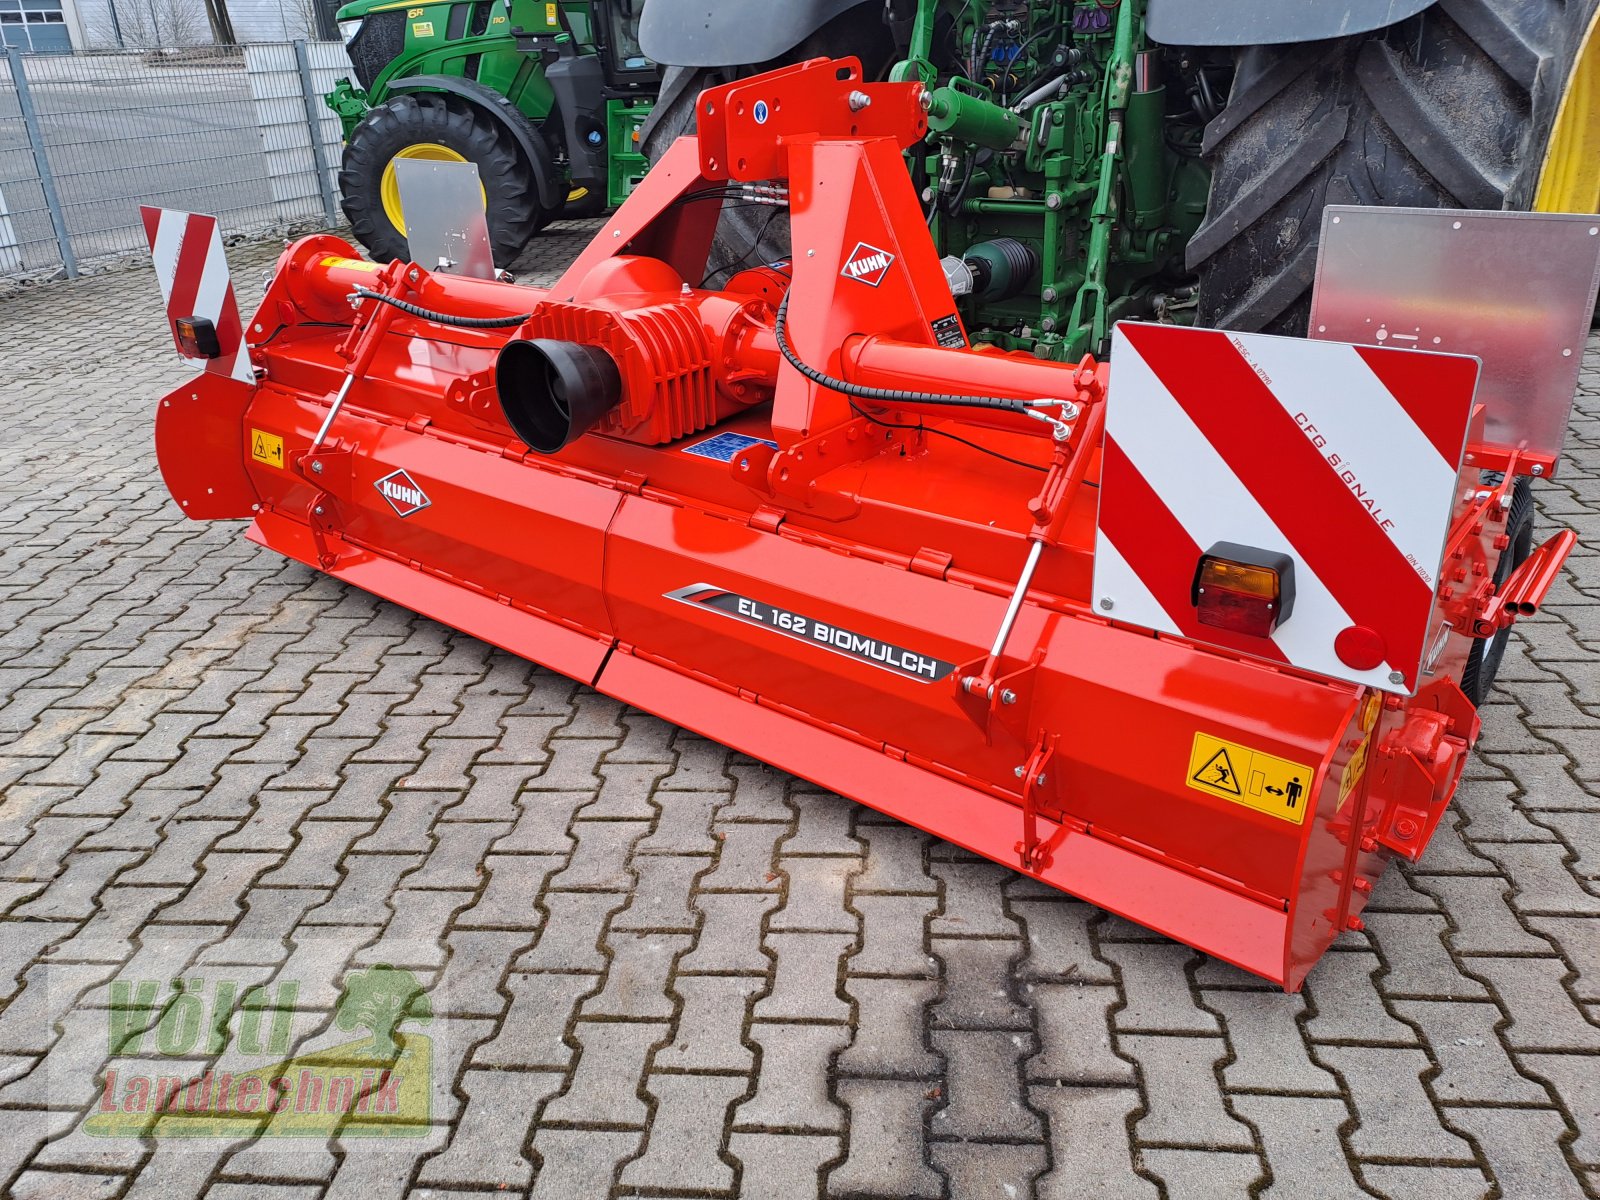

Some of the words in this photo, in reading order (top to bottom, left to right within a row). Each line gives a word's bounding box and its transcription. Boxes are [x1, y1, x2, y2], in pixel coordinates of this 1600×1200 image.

[408, 8, 424, 19] 6R
[848, 252, 888, 277] KUHN
[1232, 337, 1250, 359] TPESC
[1294, 412, 1327, 449] CFG
[383, 480, 421, 507] KUHN
[1406, 553, 1418, 567] DIN
[1415, 562, 1432, 583] 11030
[738, 598, 762, 621] EL
[771, 609, 806, 635] 162
[813, 622, 936, 679] BIOMULCH
